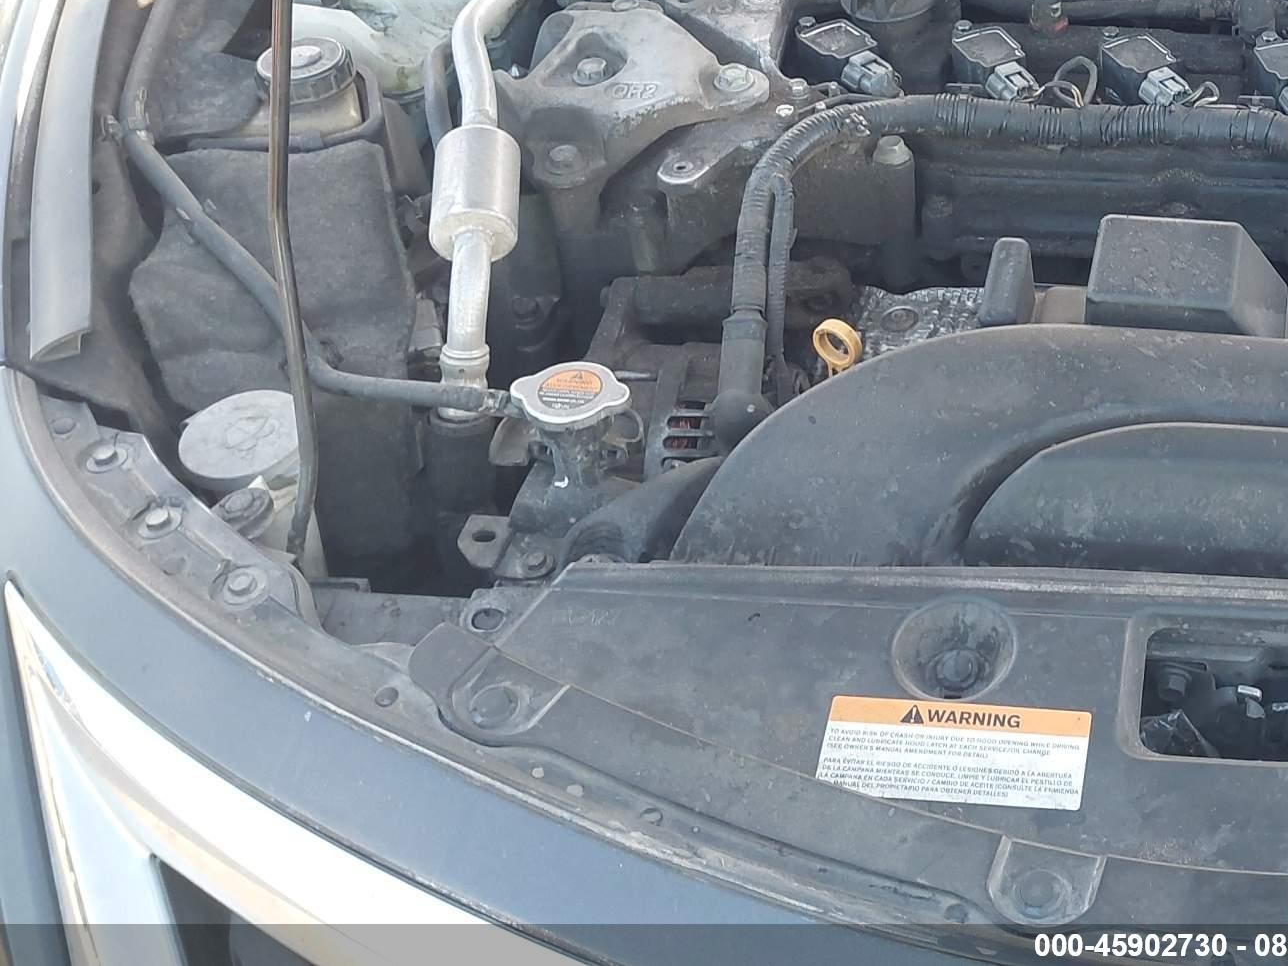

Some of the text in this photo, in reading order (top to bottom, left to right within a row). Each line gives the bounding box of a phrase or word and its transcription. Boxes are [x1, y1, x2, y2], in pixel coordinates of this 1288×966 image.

[610, 81, 659, 99] QR2
[927, 709, 1021, 729] WARNING
[875, 783, 919, 791] PROPIETARIO
